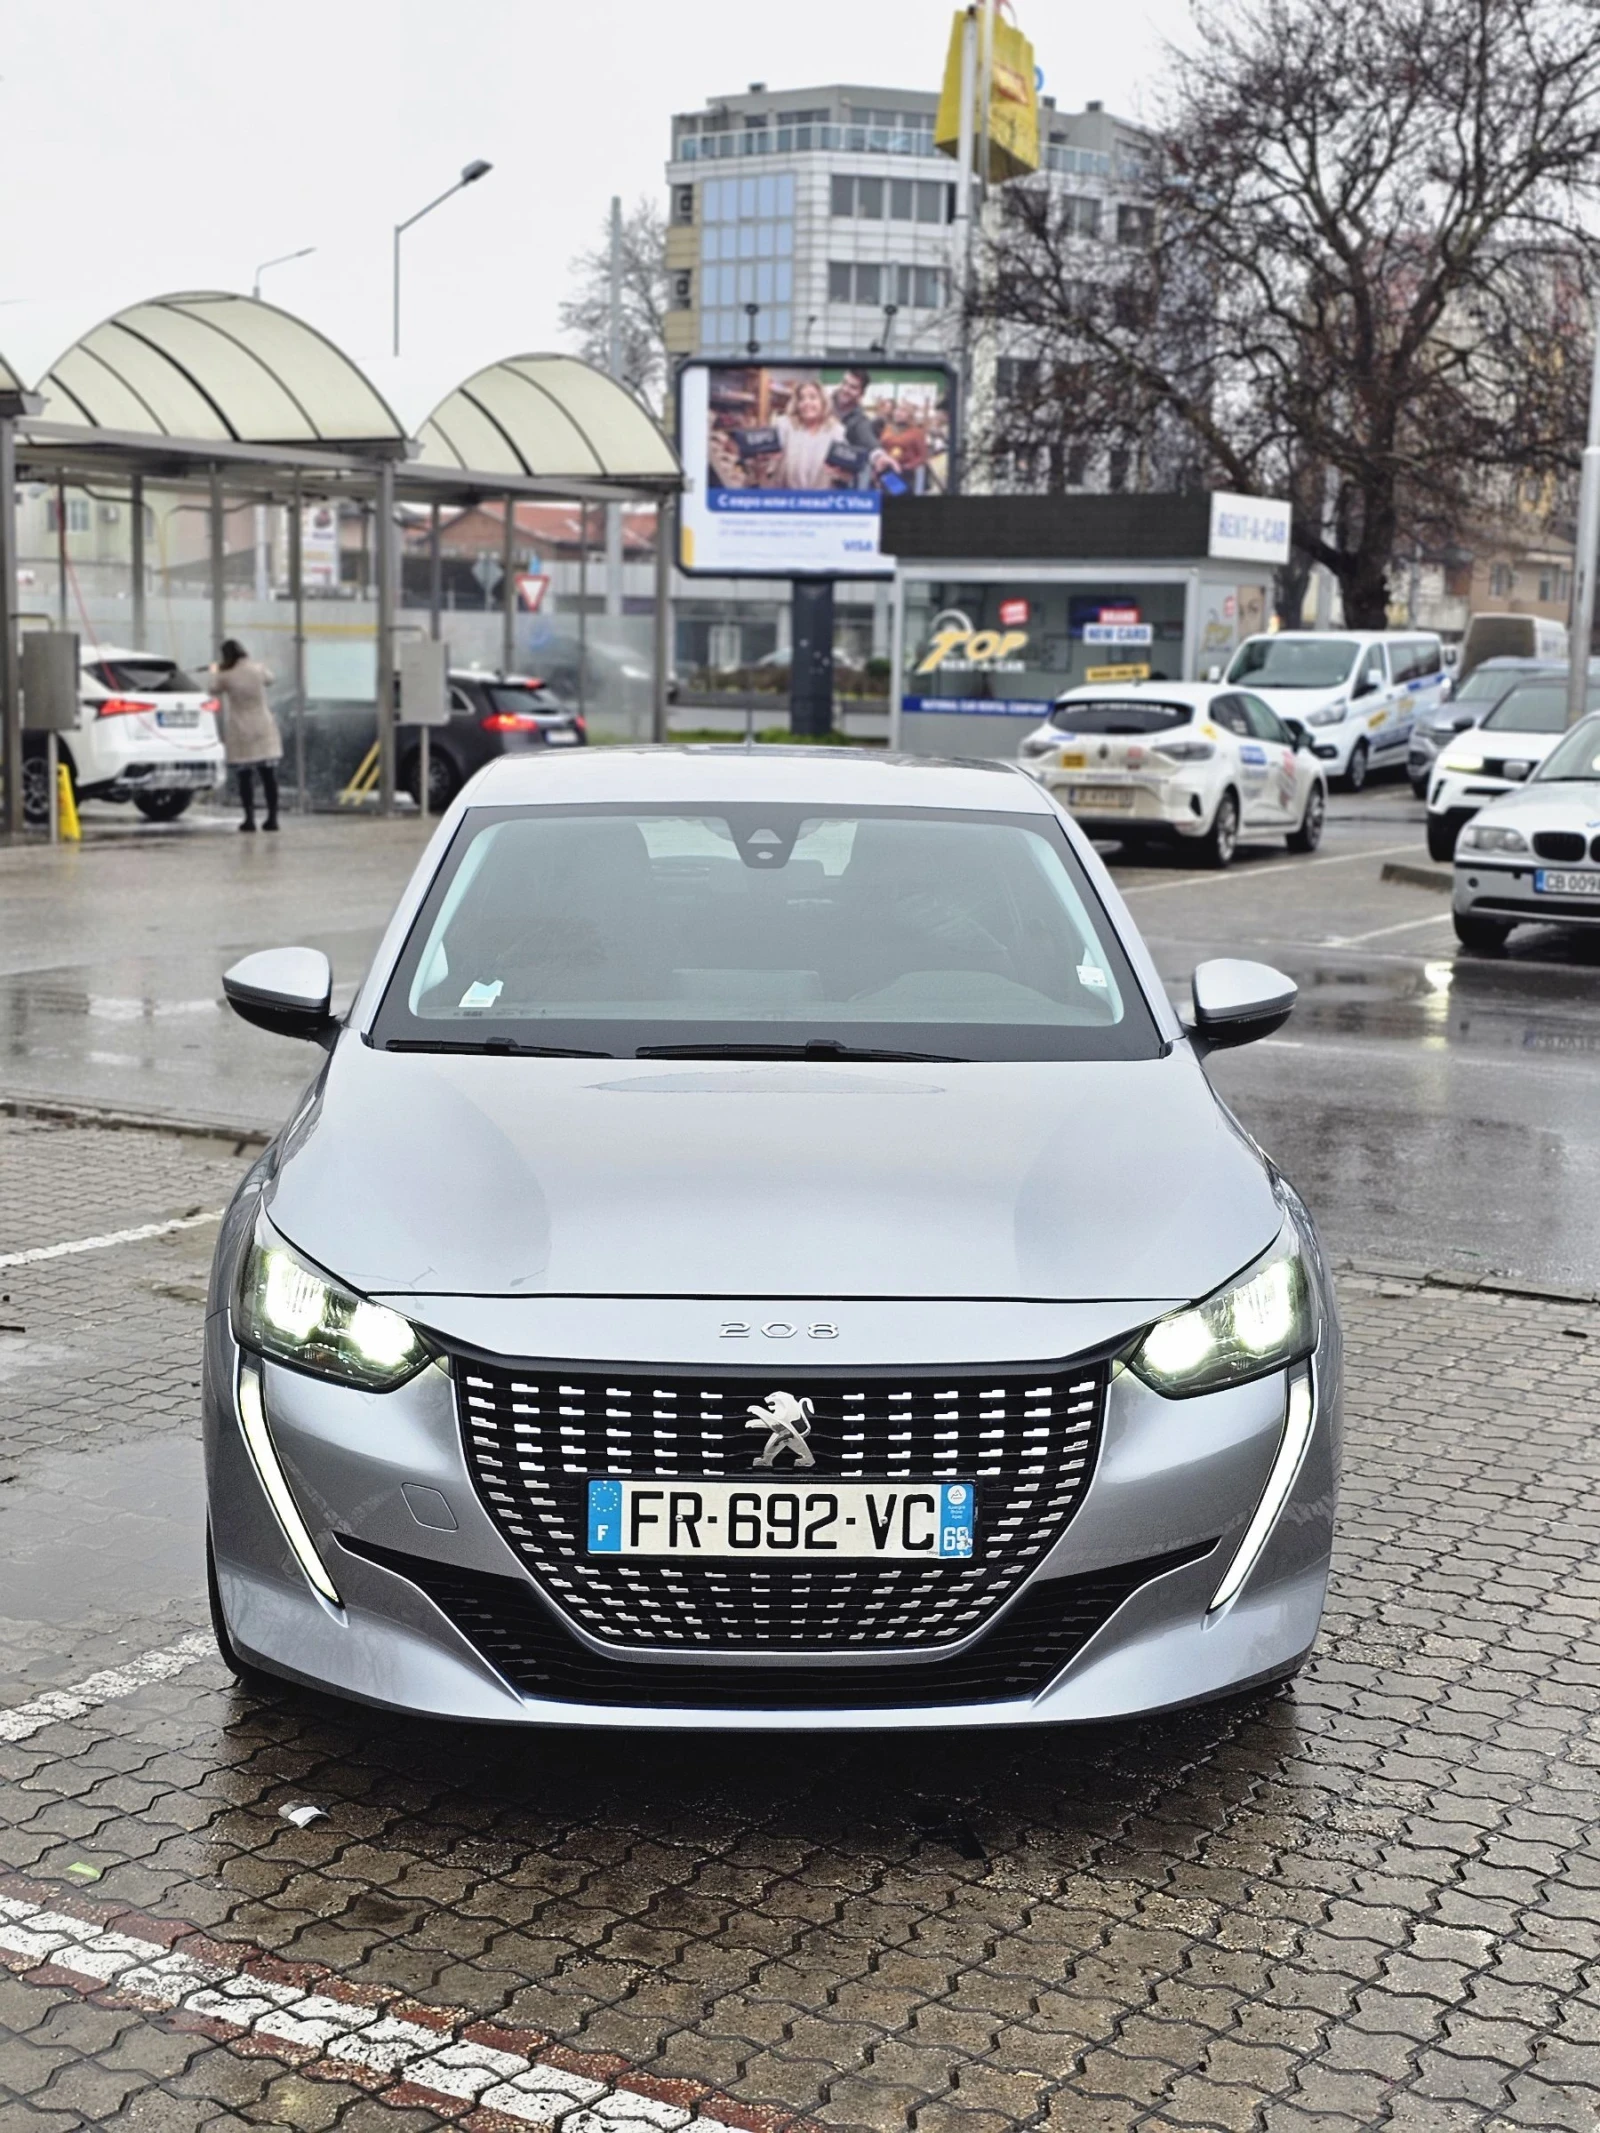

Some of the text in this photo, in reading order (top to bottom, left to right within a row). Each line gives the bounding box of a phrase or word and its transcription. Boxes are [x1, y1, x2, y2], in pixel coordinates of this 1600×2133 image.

[848, 496, 874, 509] Visa
[1219, 512, 1286, 543] RENT-A-CAR
[842, 540, 873, 551] VISA
[1089, 628, 1148, 640] NEW CARS
[915, 630, 1029, 675] TOP
[1546, 874, 1600, 892] CB 009
[718, 1321, 840, 1339] 208
[630, 1490, 936, 1551] FR-692-VC
[597, 1525, 609, 1541] F
